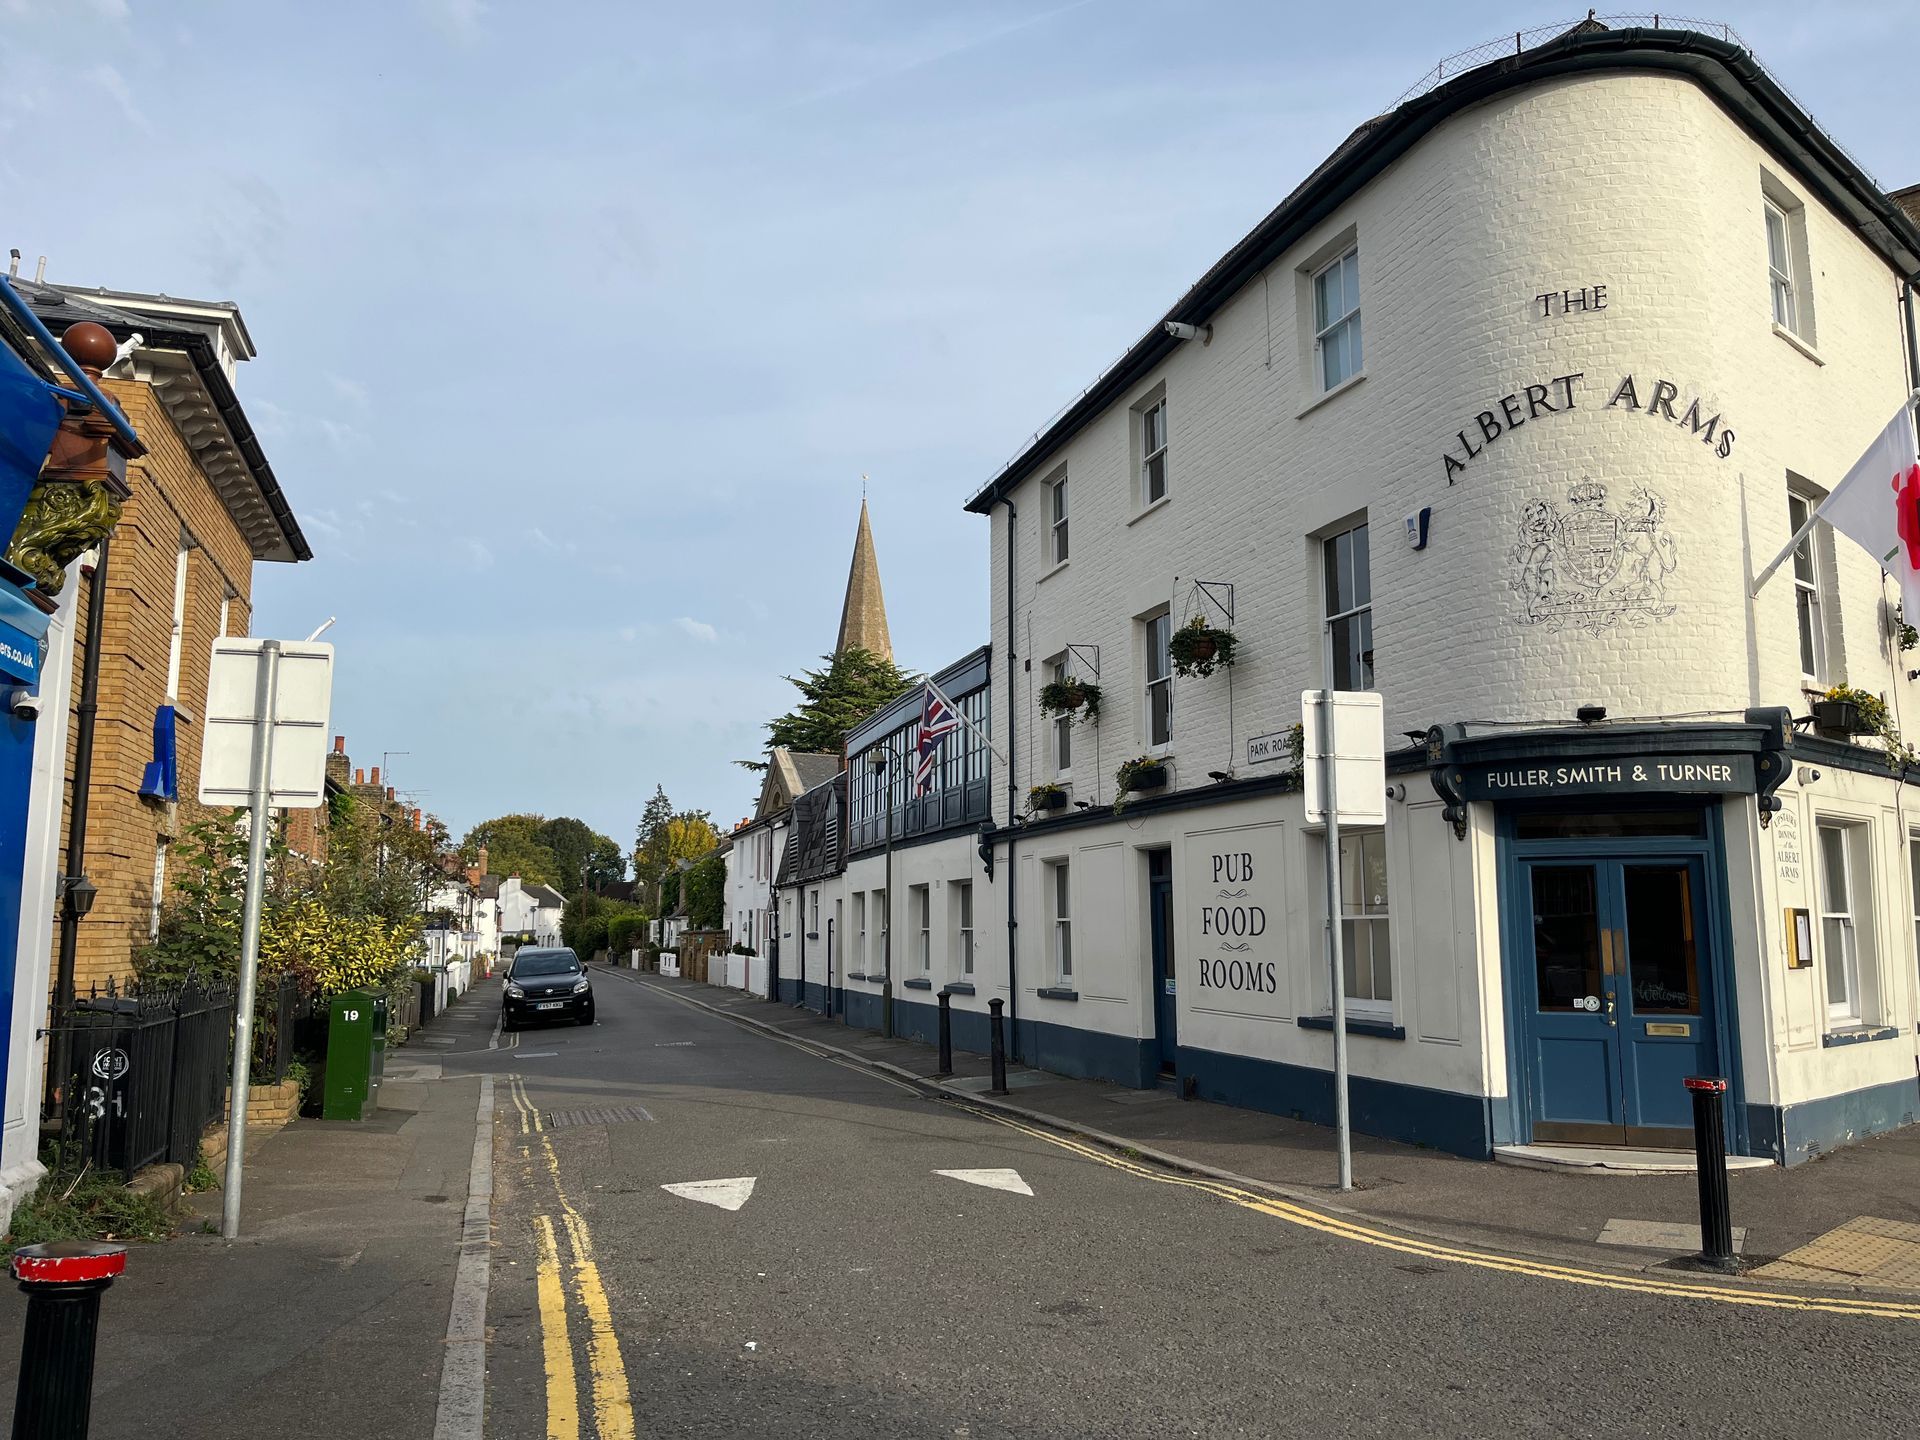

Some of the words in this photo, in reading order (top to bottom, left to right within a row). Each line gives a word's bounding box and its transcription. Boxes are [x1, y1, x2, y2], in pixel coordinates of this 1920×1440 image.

[1535, 285, 1608, 318] THE
[1442, 372, 1584, 487] ALBERT
[1608, 373, 1736, 459] ARMS
[1250, 741, 1269, 758] PARK
[1272, 737, 1289, 753] ROA
[1487, 769, 1554, 788] FULLER,
[1556, 765, 1622, 785] SMITH
[1631, 765, 1648, 782] &
[1657, 764, 1732, 782] TURNER
[1774, 813, 1797, 828] UPSTAIRS
[1778, 830, 1797, 840] DINING
[1211, 852, 1254, 883] PUB
[1778, 851, 1800, 863] ALBERT
[1780, 866, 1799, 879] ARMS
[1202, 906, 1266, 937] FOOD
[1199, 958, 1277, 994] ROOMS
[343, 1010, 359, 1021] 19
